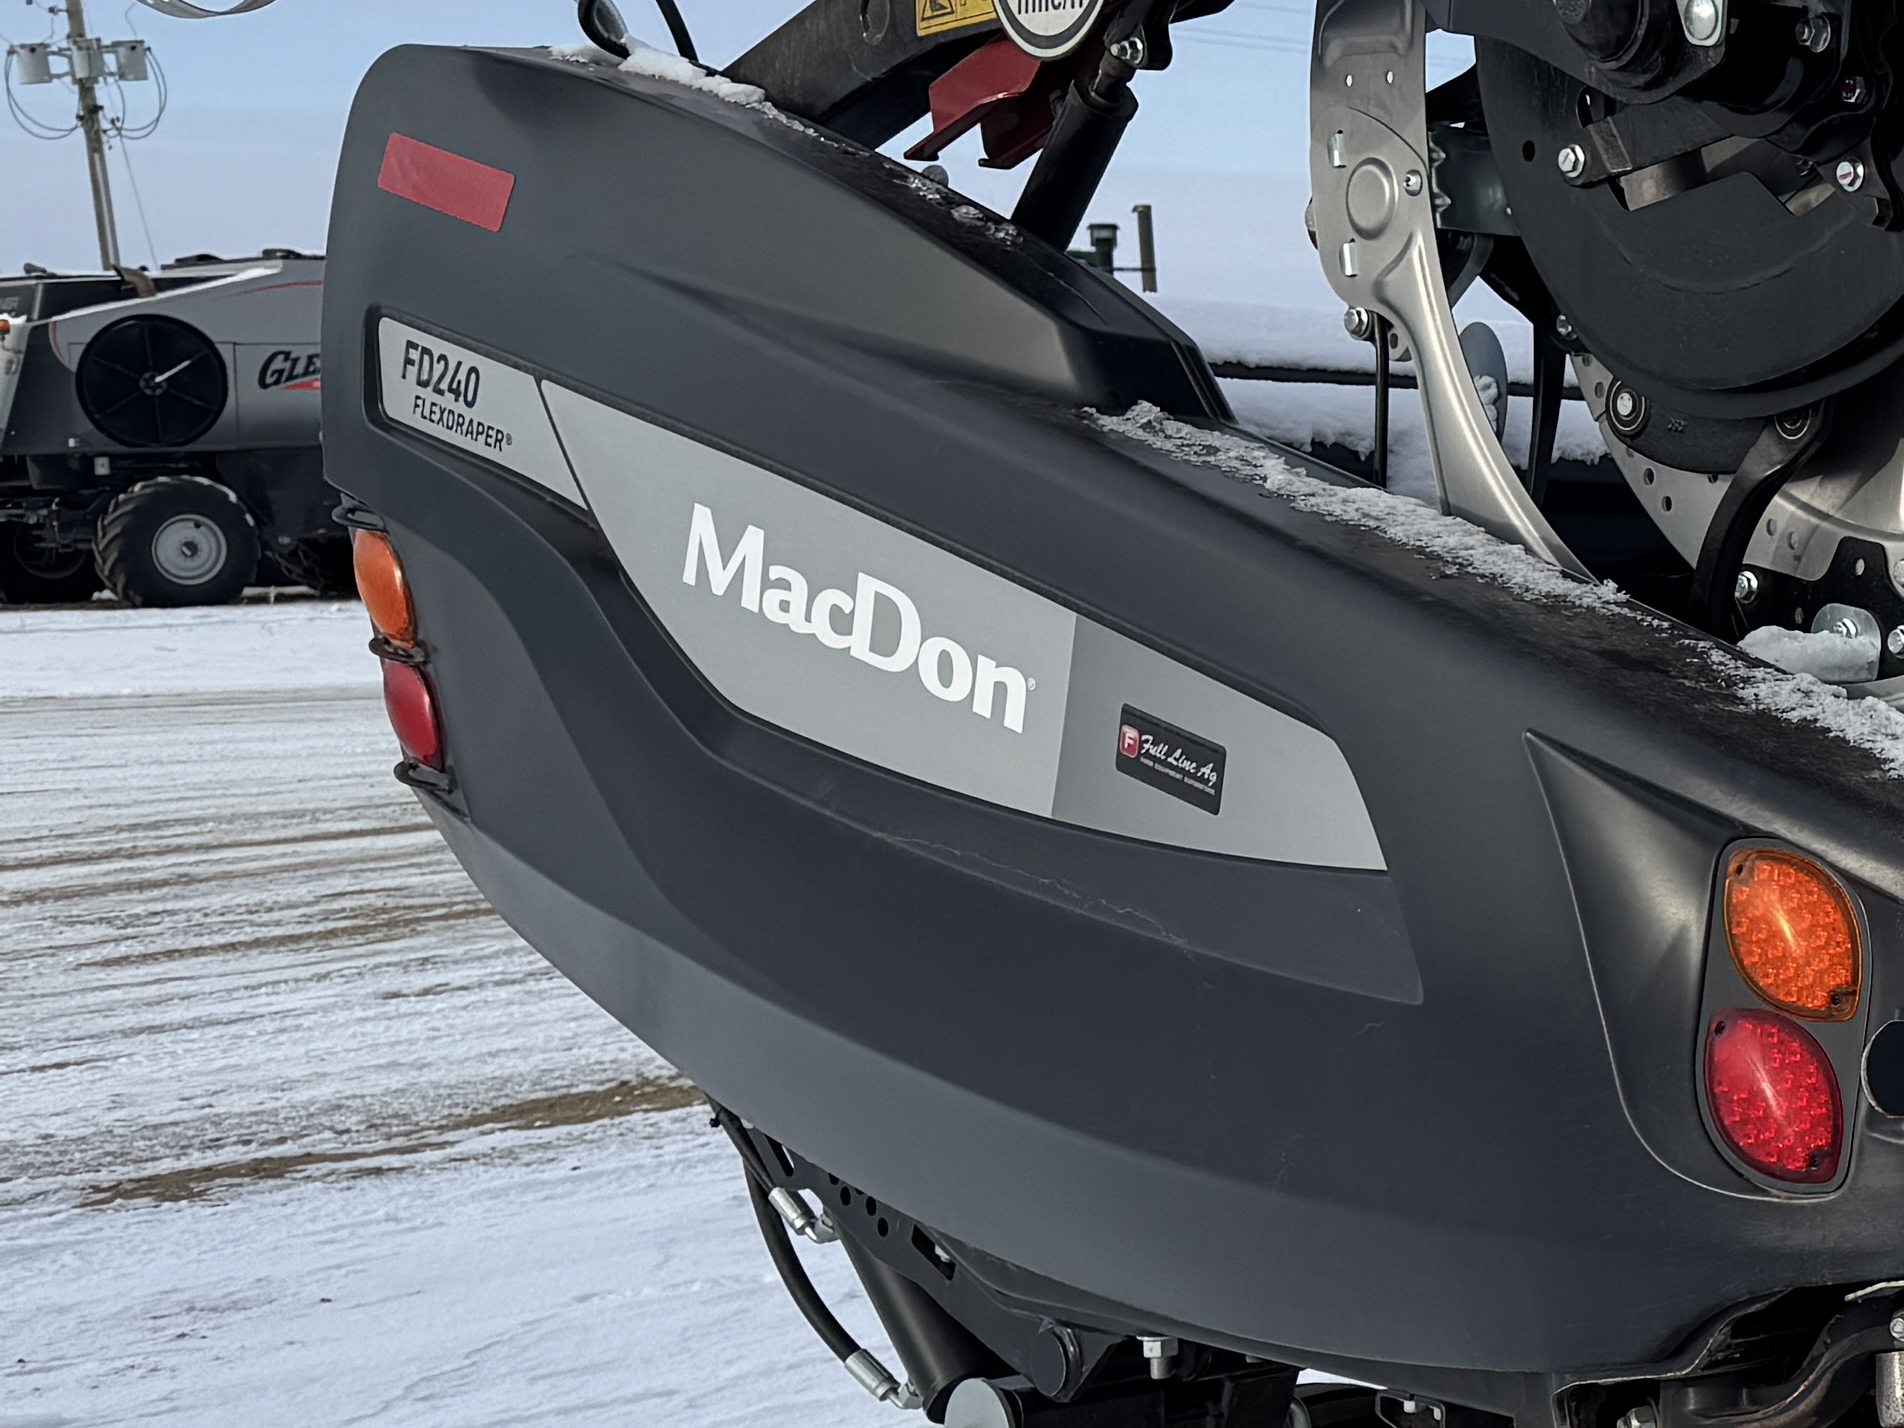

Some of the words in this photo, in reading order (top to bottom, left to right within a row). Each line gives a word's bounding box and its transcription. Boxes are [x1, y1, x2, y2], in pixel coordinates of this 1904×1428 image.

[401, 339, 480, 409] FD240
[1140, 734, 1169, 760] Full
[1167, 748, 1197, 773] Line
[1197, 762, 1217, 787] Ag
